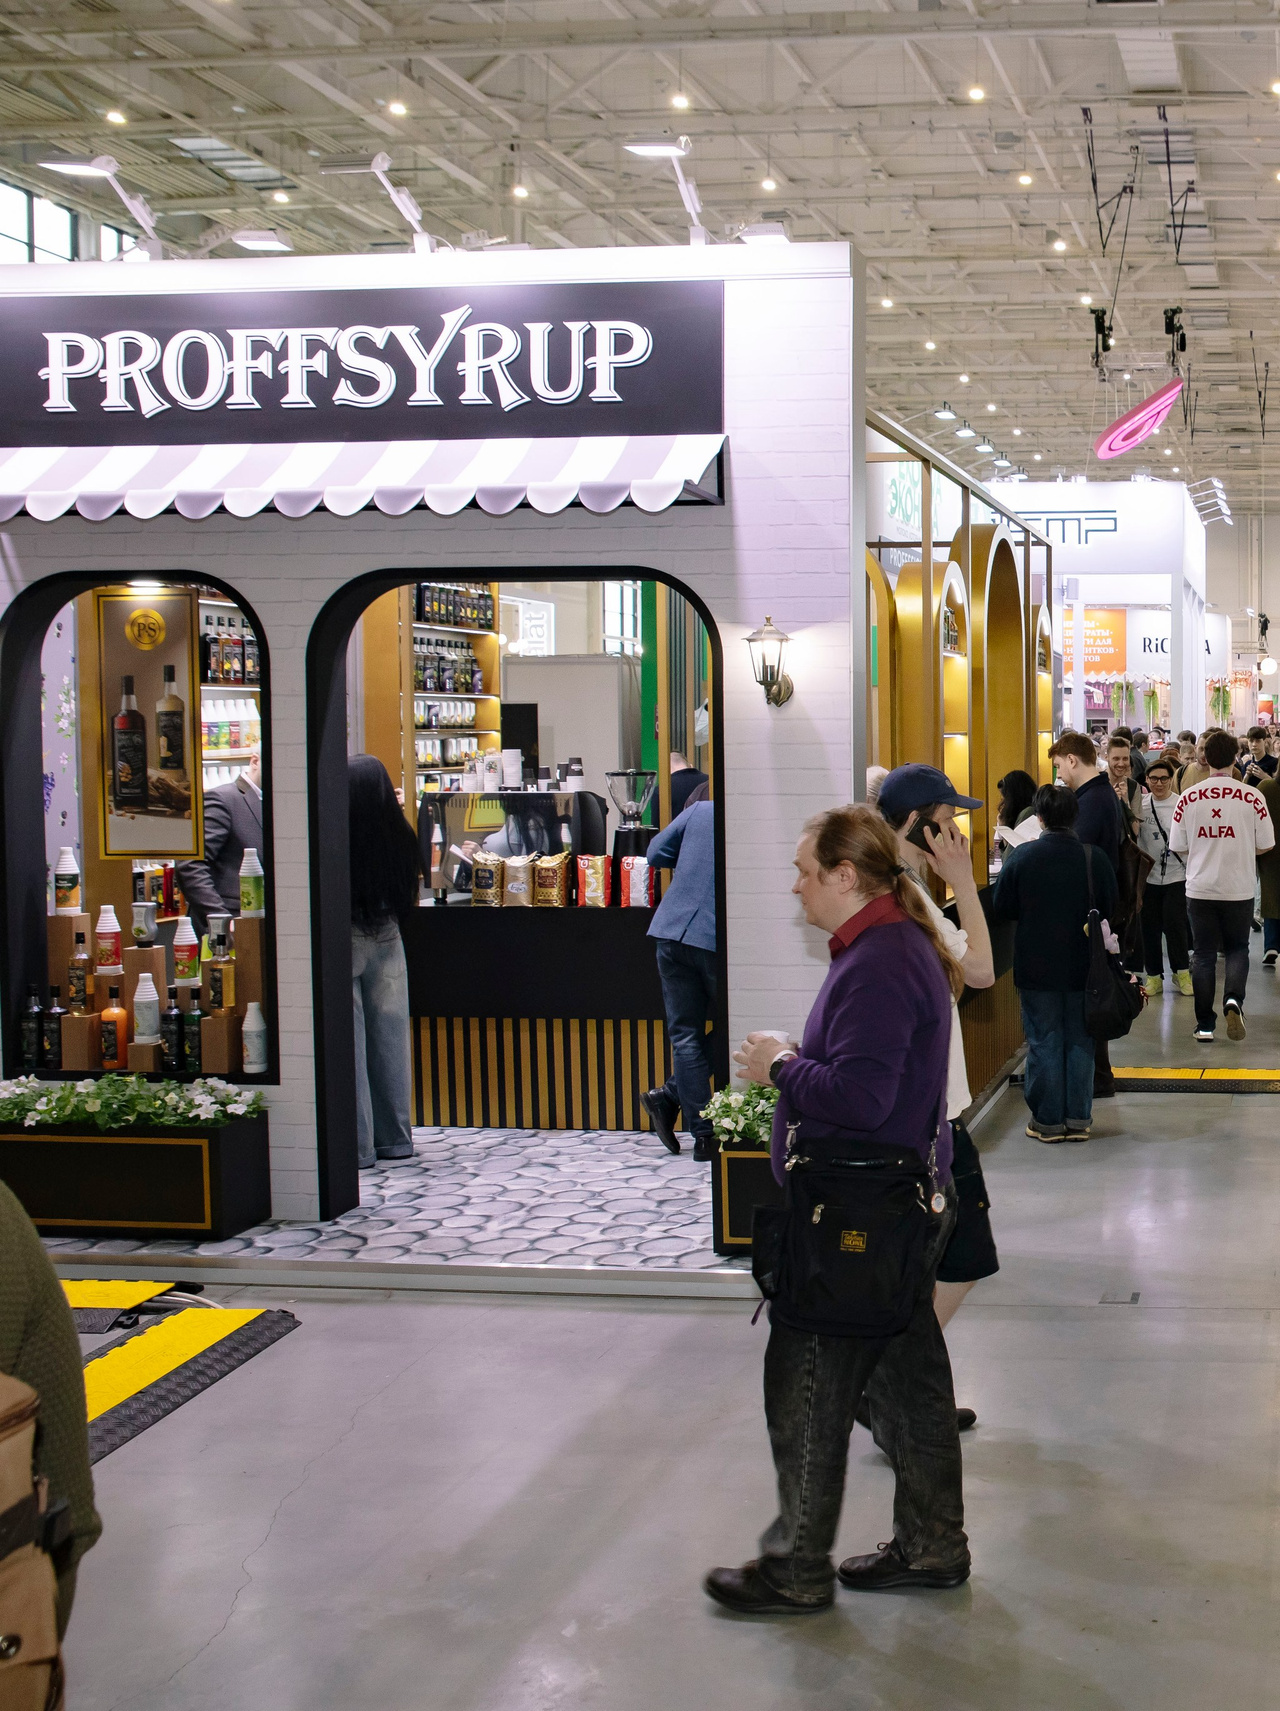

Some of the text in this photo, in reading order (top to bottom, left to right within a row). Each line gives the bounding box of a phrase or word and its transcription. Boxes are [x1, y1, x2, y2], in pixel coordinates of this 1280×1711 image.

[38, 304, 654, 419] PROFFSYRUP
[1173, 787, 1268, 823] BRICKSPACER
[1197, 826, 1236, 838] ALFA
